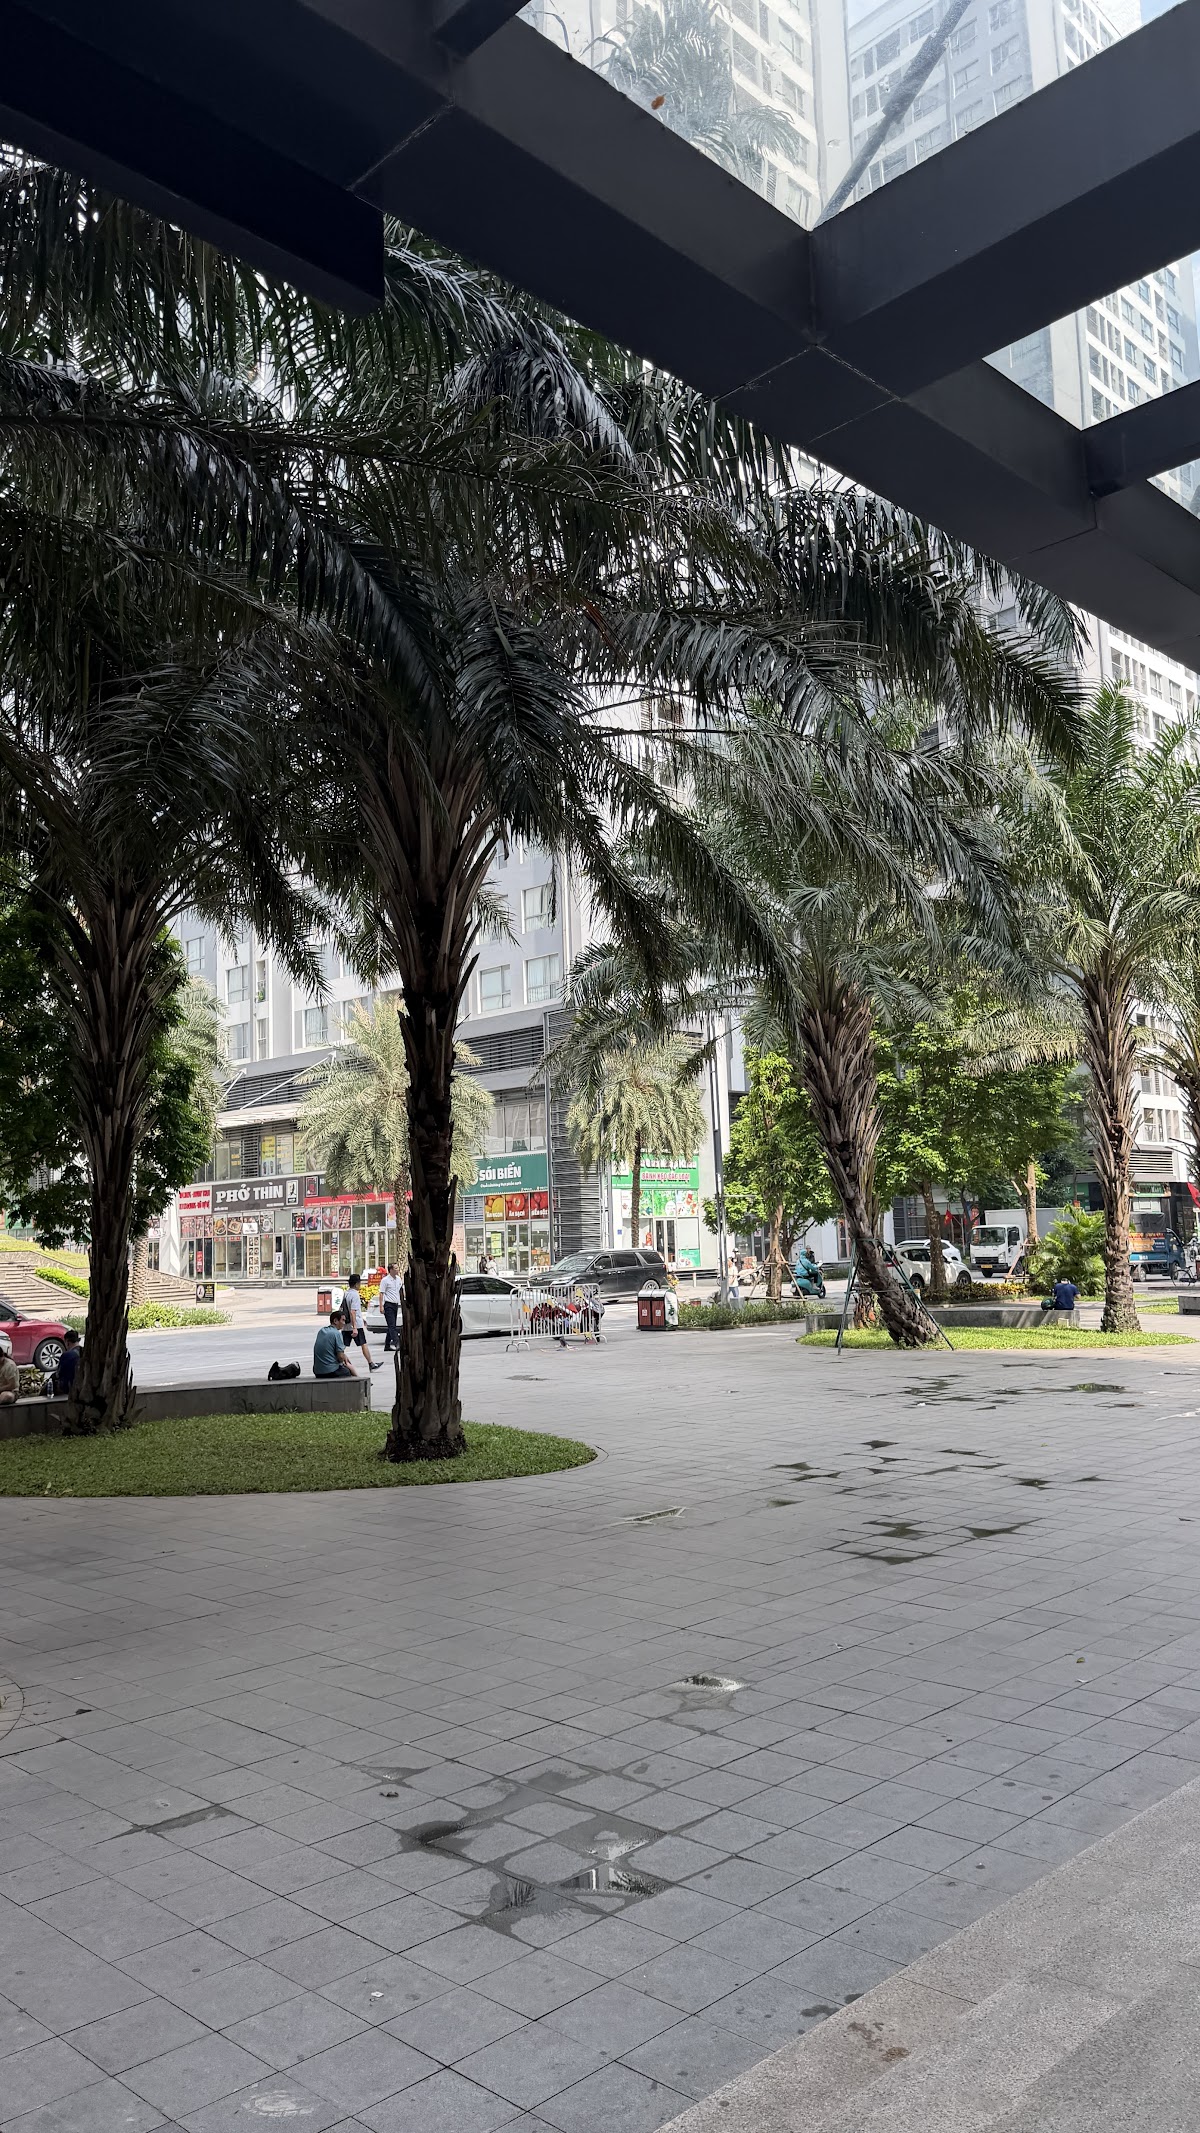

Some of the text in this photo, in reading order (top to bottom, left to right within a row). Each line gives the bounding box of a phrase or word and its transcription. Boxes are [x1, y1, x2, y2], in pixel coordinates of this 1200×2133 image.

[480, 1162, 522, 1181] SÓI BIỂN
[642, 1172, 656, 1180] BÁNH
[216, 1184, 250, 1203] PHỞ
[253, 1182, 283, 1200] THÌN
